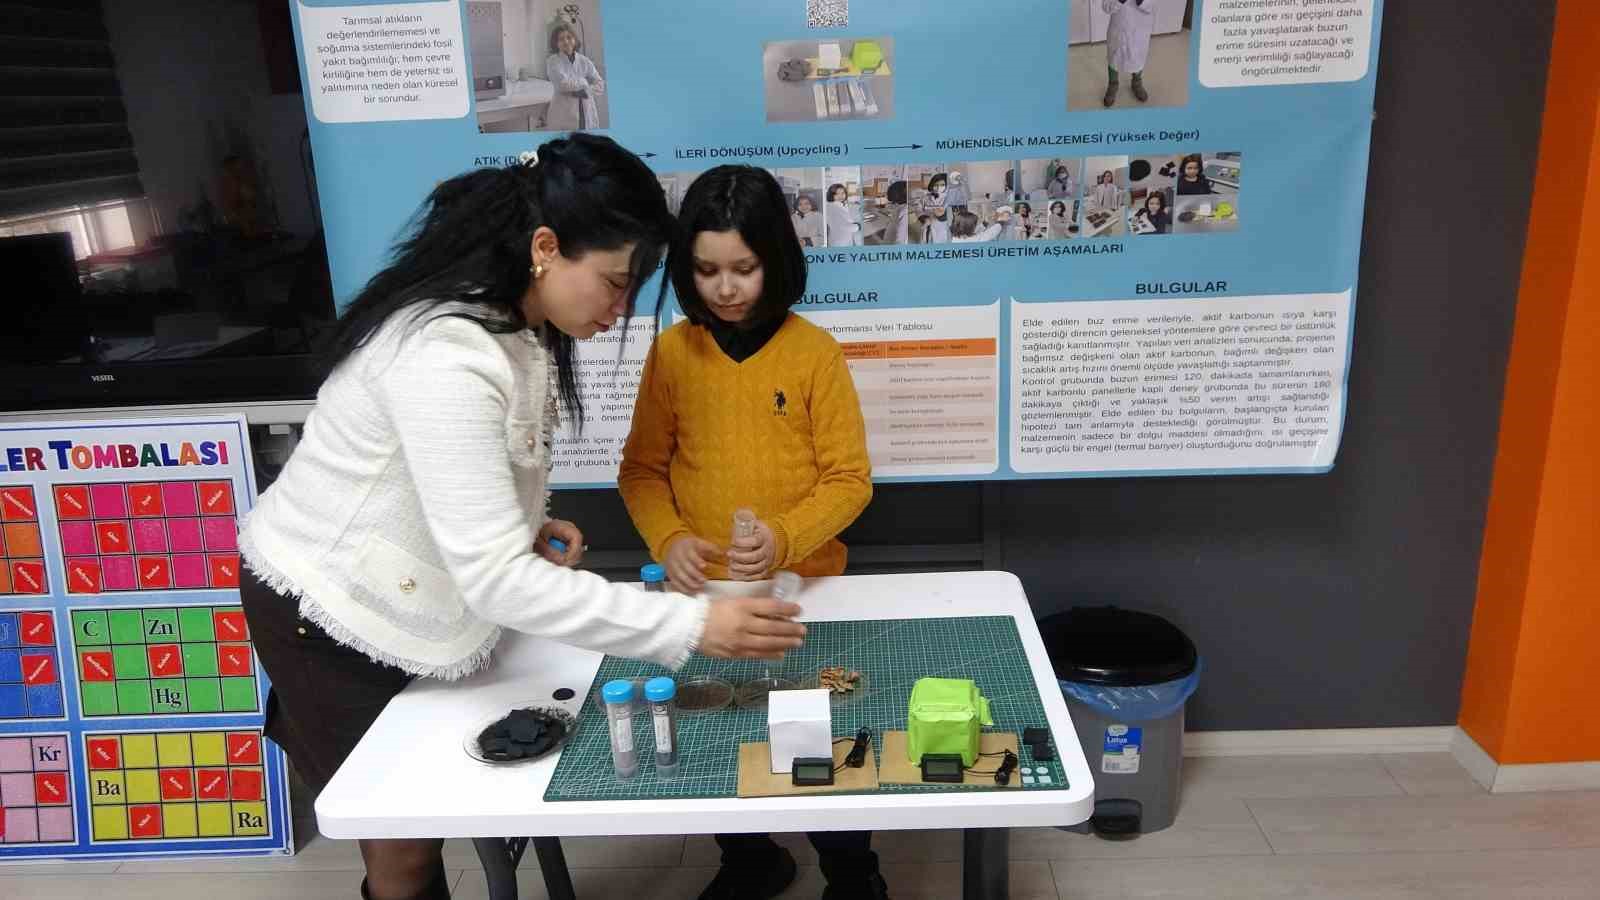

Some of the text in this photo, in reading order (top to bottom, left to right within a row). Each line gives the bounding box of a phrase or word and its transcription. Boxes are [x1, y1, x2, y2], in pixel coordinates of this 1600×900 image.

[344, 15, 382, 24] Tarımsal
[1254, 12, 1278, 23] göre
[1336, 9, 1362, 18] daha
[1318, 23, 1348, 32] buzun
[322, 57, 346, 68] yakıt
[402, 54, 423, 63] hem
[426, 55, 450, 64] çevre
[368, 68, 388, 77] hem
[390, 67, 402, 76] de
[372, 81, 400, 90] neden
[402, 80, 423, 89] olan
[425, 79, 458, 88] küresel
[364, 95, 376, 103] bir
[936, 130, 1200, 150] MÜHENDİSLİK MALZEMESİ (Yüksek Değer)
[675, 146, 707, 158] İLERİ
[710, 145, 774, 159] DÖNÜŞÜM
[778, 144, 841, 158] (Upcycling
[474, 156, 500, 166] ATIK
[829, 243, 1124, 263] VE YALITIM MALZEMESİ ÜRETİM AŞAMALARI
[1136, 280, 1228, 294] BULGULAR
[1022, 318, 1044, 326] Elde
[1088, 316, 1104, 324] buz
[1230, 311, 1274, 320] karbonun
[1218, 324, 1240, 334] göre
[1120, 350, 1140, 358] olan
[1022, 376, 1054, 384] Kontrol
[1102, 408, 1122, 416] Elde
[1162, 407, 1173, 415] bu
[1272, 416, 1286, 424] Bu
[1120, 431, 1131, 439] bir
[48, 440, 229, 470] TOMBALASI
[83, 619, 174, 637] C Zn
[156, 688, 182, 708] Hg
[38, 747, 61, 761] Kr
[96, 780, 121, 796] Ba
[238, 813, 263, 828] Ra
